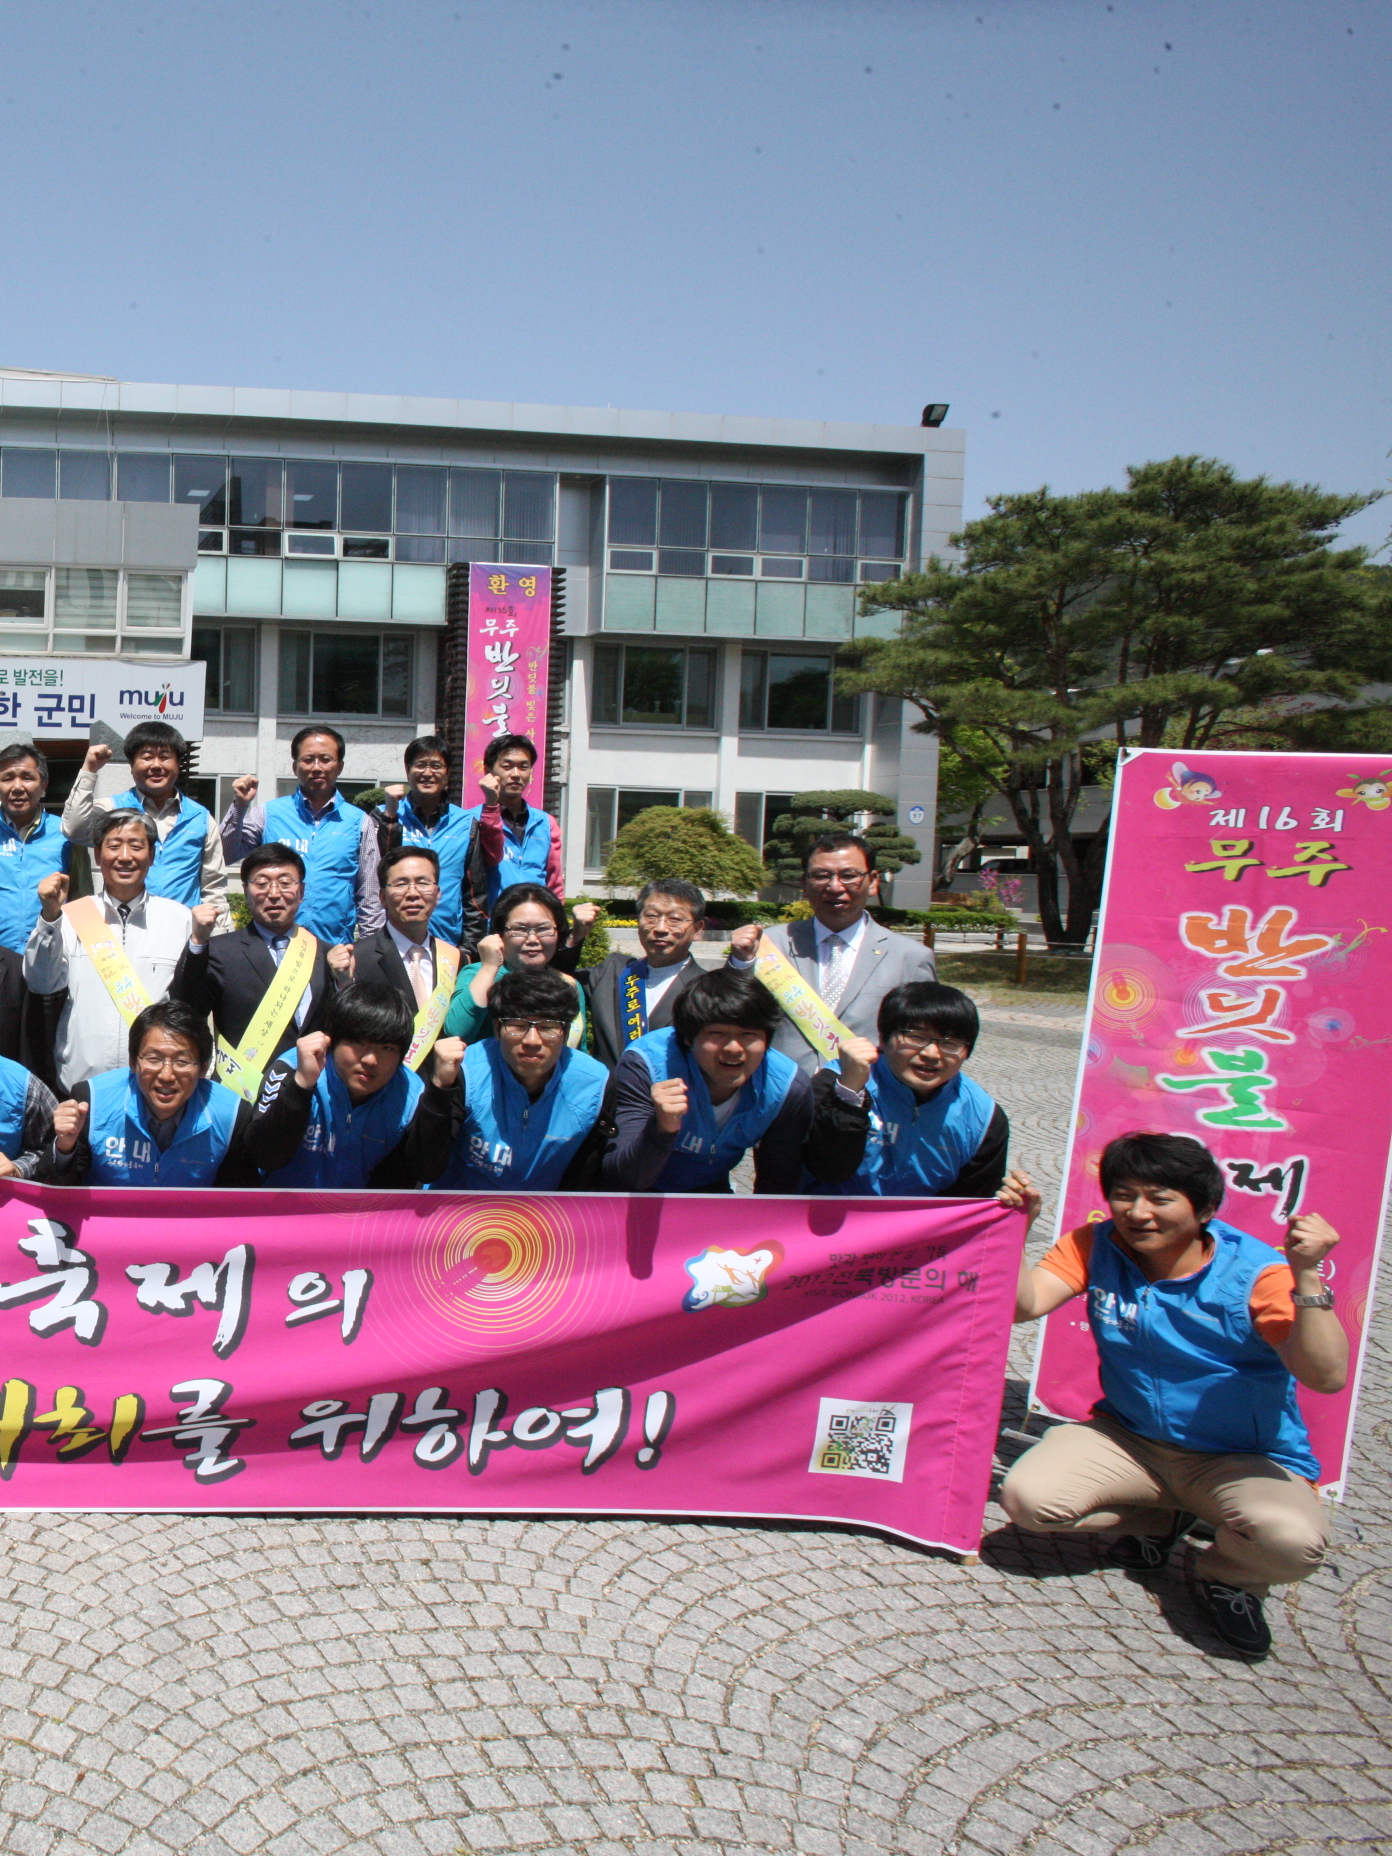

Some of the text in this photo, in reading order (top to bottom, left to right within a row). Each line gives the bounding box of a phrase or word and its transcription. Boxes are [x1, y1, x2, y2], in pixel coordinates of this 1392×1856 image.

[486, 574, 538, 598] 환영
[479, 618, 520, 638] 무주
[13, 669, 64, 687] 발전을!
[33, 692, 97, 728] 군민
[119, 712, 185, 721] Welcome to MUJU
[1183, 837, 1355, 887] 무주
[270, 985, 291, 1018] 하나되는
[625, 973, 642, 1013] 무주로
[259, 1020, 274, 1037] 세상
[105, 1136, 152, 1163] 안내
[288, 1385, 678, 1476] 위하여!
